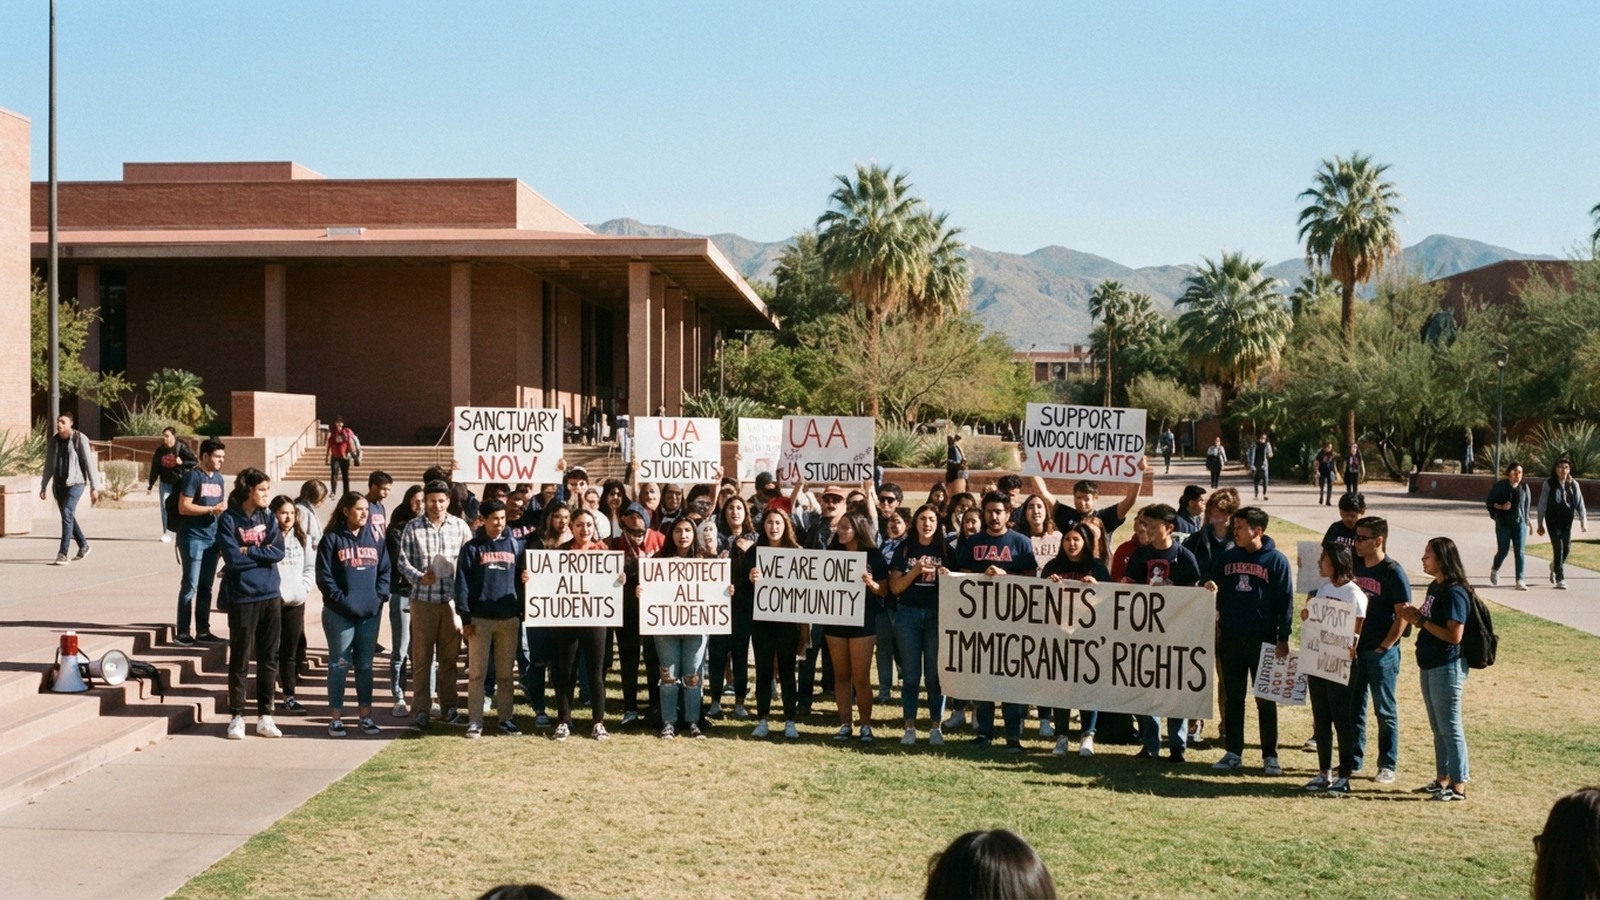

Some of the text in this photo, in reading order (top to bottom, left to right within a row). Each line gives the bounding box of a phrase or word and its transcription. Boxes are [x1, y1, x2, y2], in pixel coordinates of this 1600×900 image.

[459, 410, 557, 432] SANCTUARY
[1040, 406, 1125, 430] SUPPORT
[658, 419, 700, 441] UA
[789, 418, 849, 449] UAA
[1027, 429, 1144, 453] UNDOCUMENTED
[473, 433, 544, 453] CAMPUS
[660, 442, 693, 458] ONE
[477, 455, 537, 480] NOW
[640, 460, 718, 480] STUDENTS
[804, 462, 872, 482] STUDENTS
[1037, 451, 1137, 478] WILDCATS
[529, 553, 552, 574] UA
[559, 553, 622, 574] PROTECT
[973, 545, 1013, 562] UAA
[643, 561, 727, 582] UA PROTECT
[758, 554, 857, 583] WE ARE ONE
[556, 575, 589, 595] ALL
[674, 584, 705, 603] ALL
[528, 596, 615, 618] STUDENTS
[756, 585, 861, 617] COMMUNITY
[958, 579, 1166, 634] STUDENTS FOR
[647, 604, 729, 627] STUDENTS
[1112, 641, 1207, 693] RIGHTS
